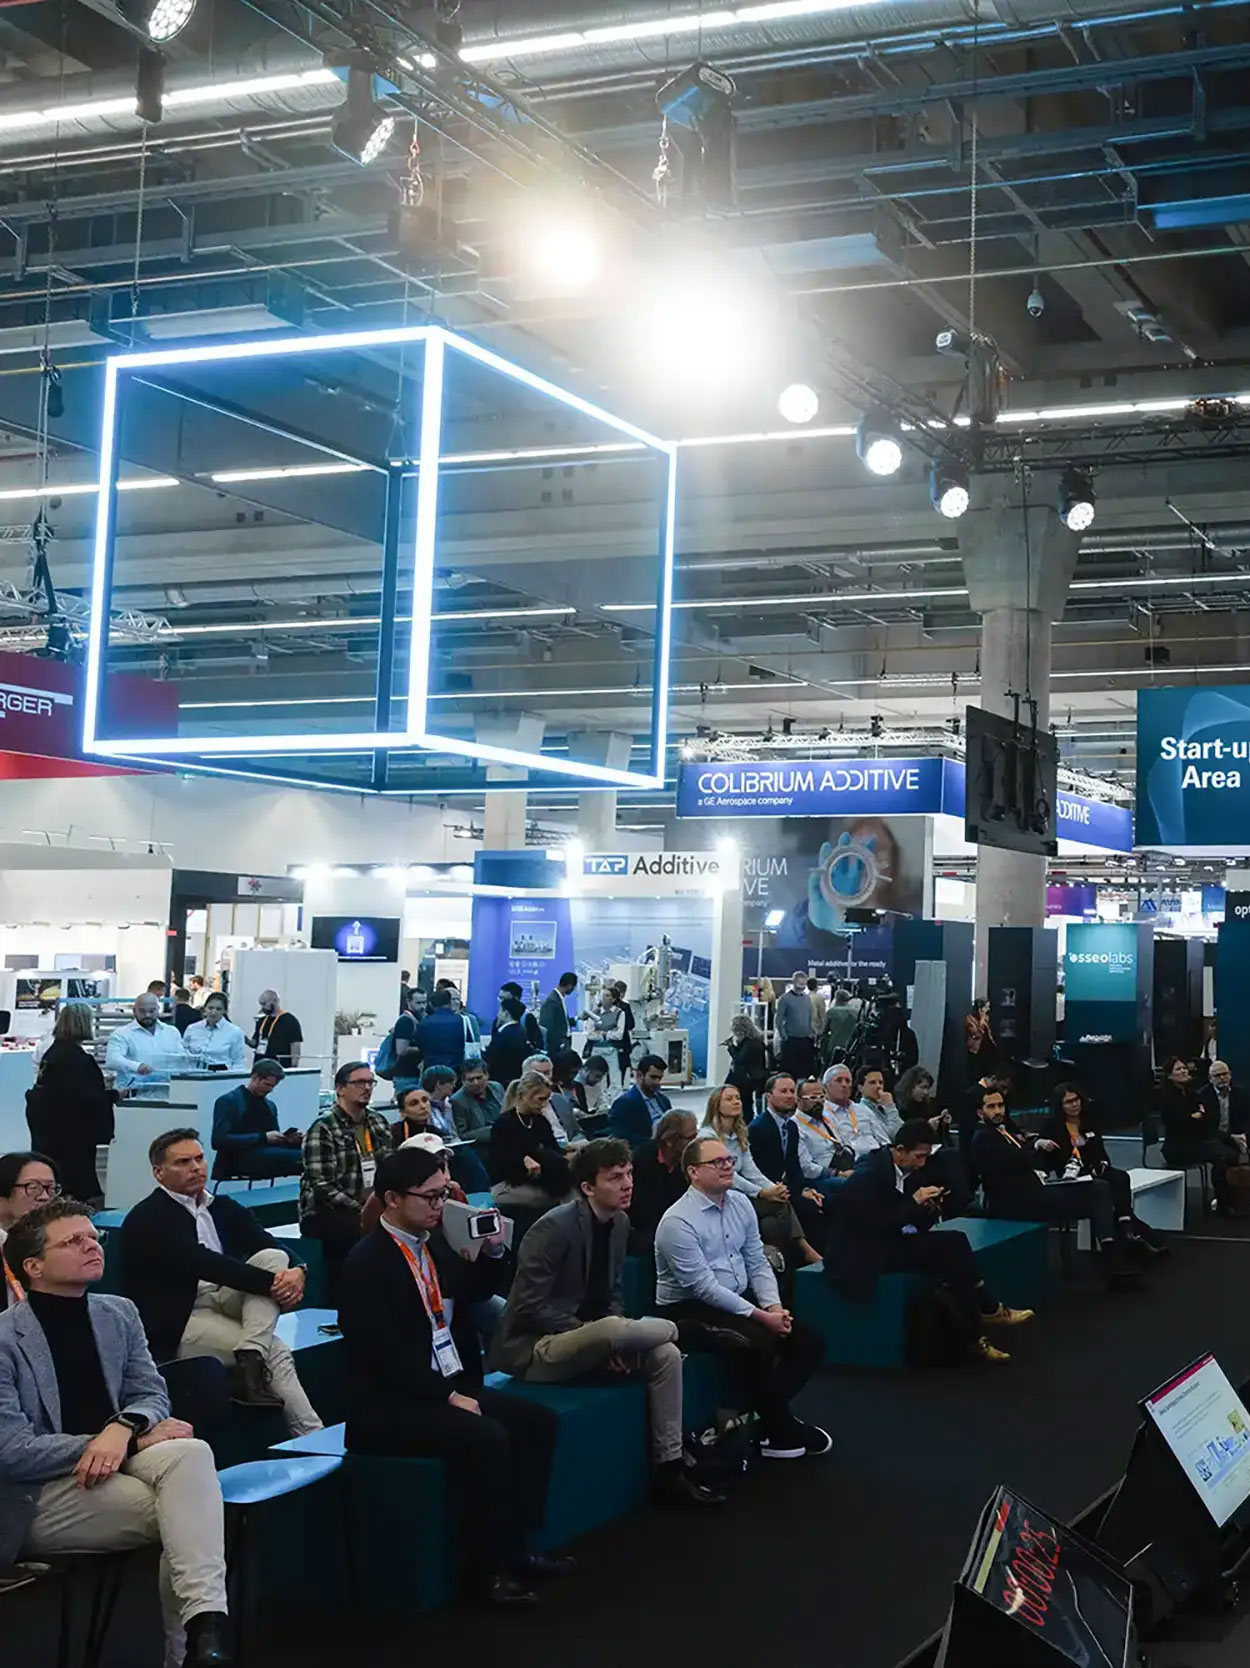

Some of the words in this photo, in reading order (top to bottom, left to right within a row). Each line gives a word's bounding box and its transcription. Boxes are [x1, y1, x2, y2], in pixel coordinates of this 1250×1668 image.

[698, 770, 814, 794] COLIBRIUM
[820, 768, 920, 791] ADDITIVE
[1181, 764, 1241, 789] Area
[704, 796, 716, 806] GE
[717, 796, 757, 808] Aerospace
[757, 796, 793, 807] company
[584, 856, 627, 873] TAP
[633, 855, 720, 876] Additive
